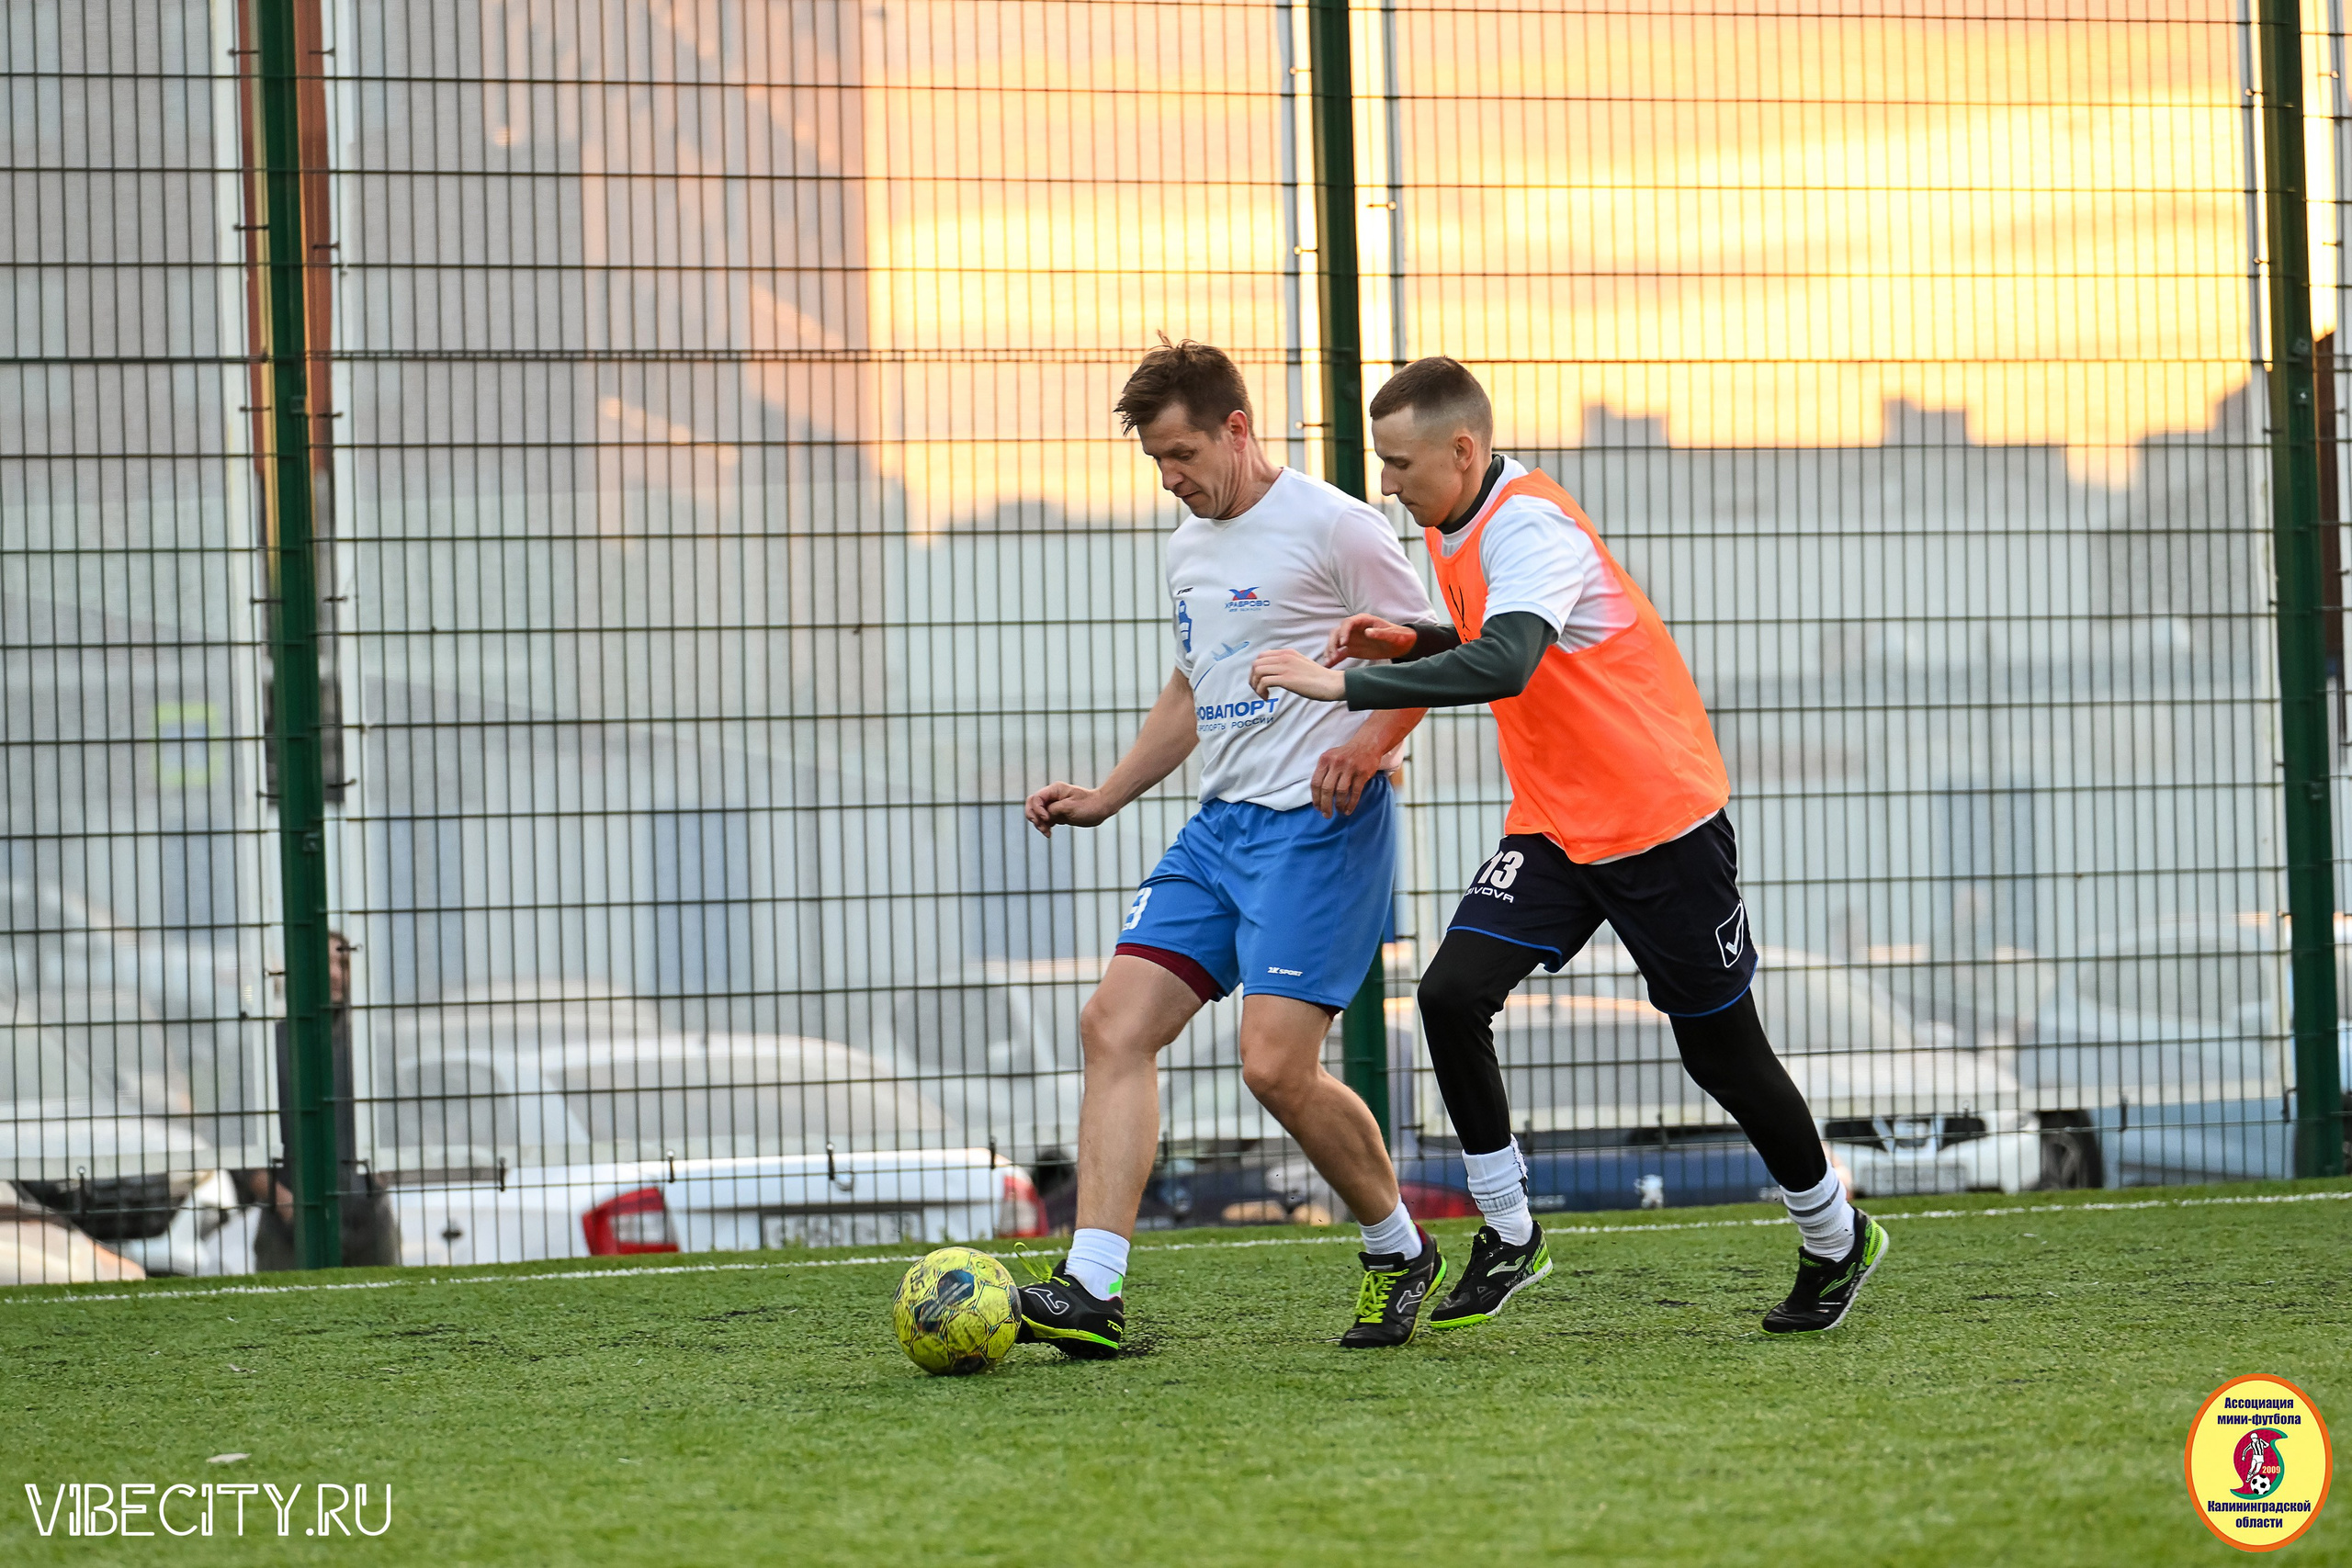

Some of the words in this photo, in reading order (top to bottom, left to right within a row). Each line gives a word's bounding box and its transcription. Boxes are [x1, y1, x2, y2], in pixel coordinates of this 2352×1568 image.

[1225, 600, 1271, 608] ХРАБРОВО
[1196, 698, 1279, 720] ОВАПОРТ
[1231, 716, 1274, 728] РОССИИ
[1477, 851, 1524, 889] 13
